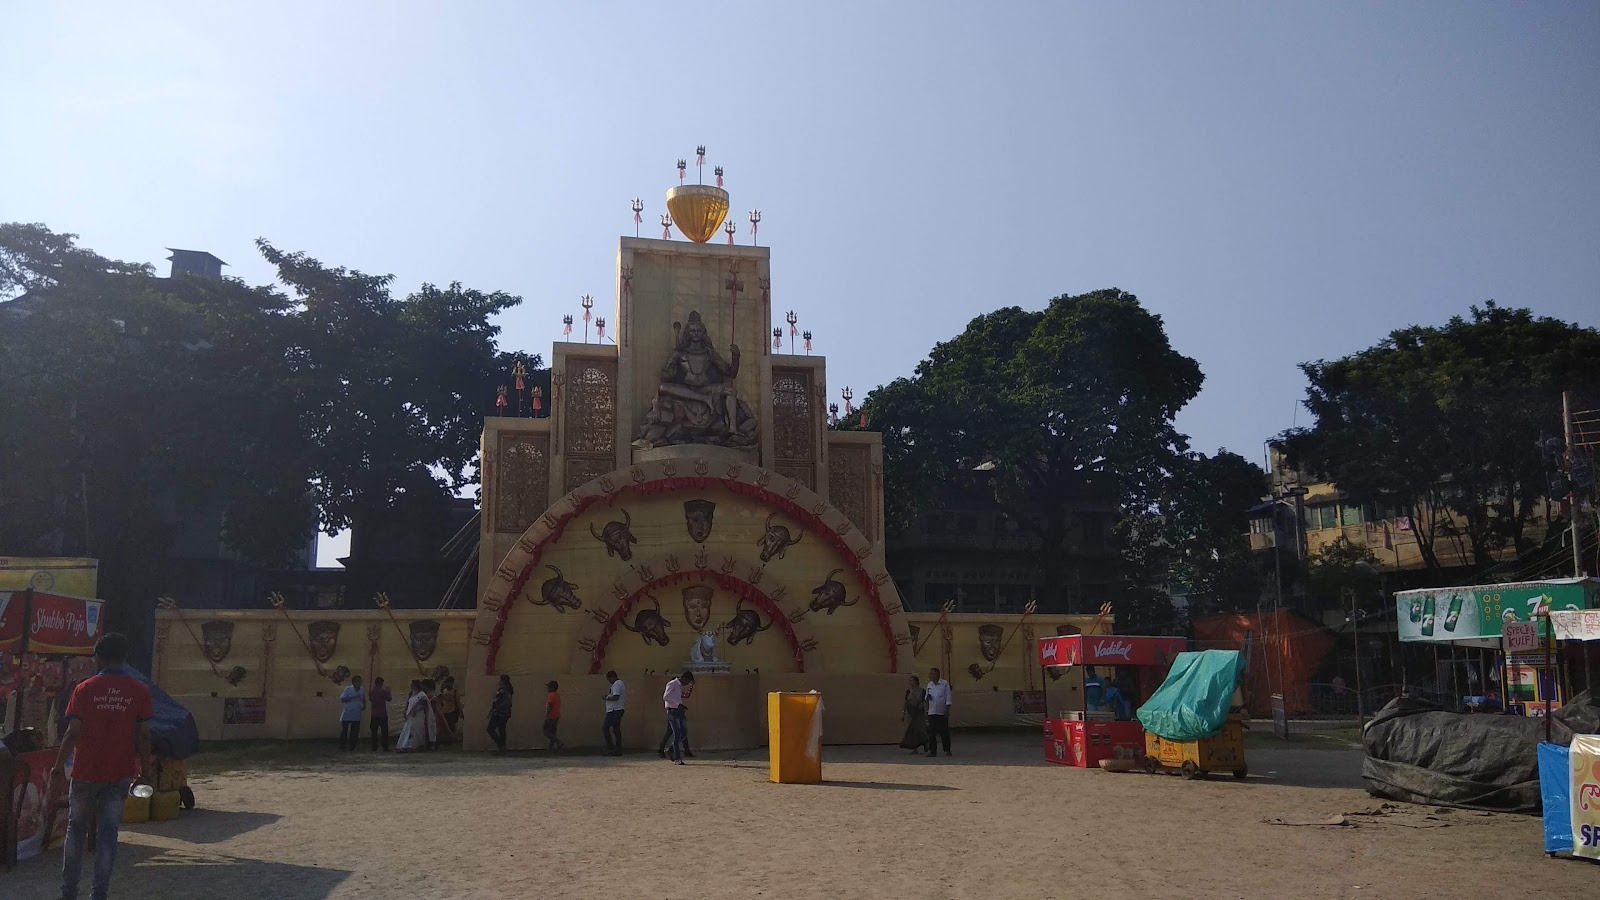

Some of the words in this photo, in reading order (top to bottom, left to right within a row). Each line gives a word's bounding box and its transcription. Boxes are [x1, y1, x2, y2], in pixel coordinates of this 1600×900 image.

[1508, 634, 1535, 648] KULFI
[1093, 639, 1132, 661] Vadilal
[96, 703, 127, 712] everyday
